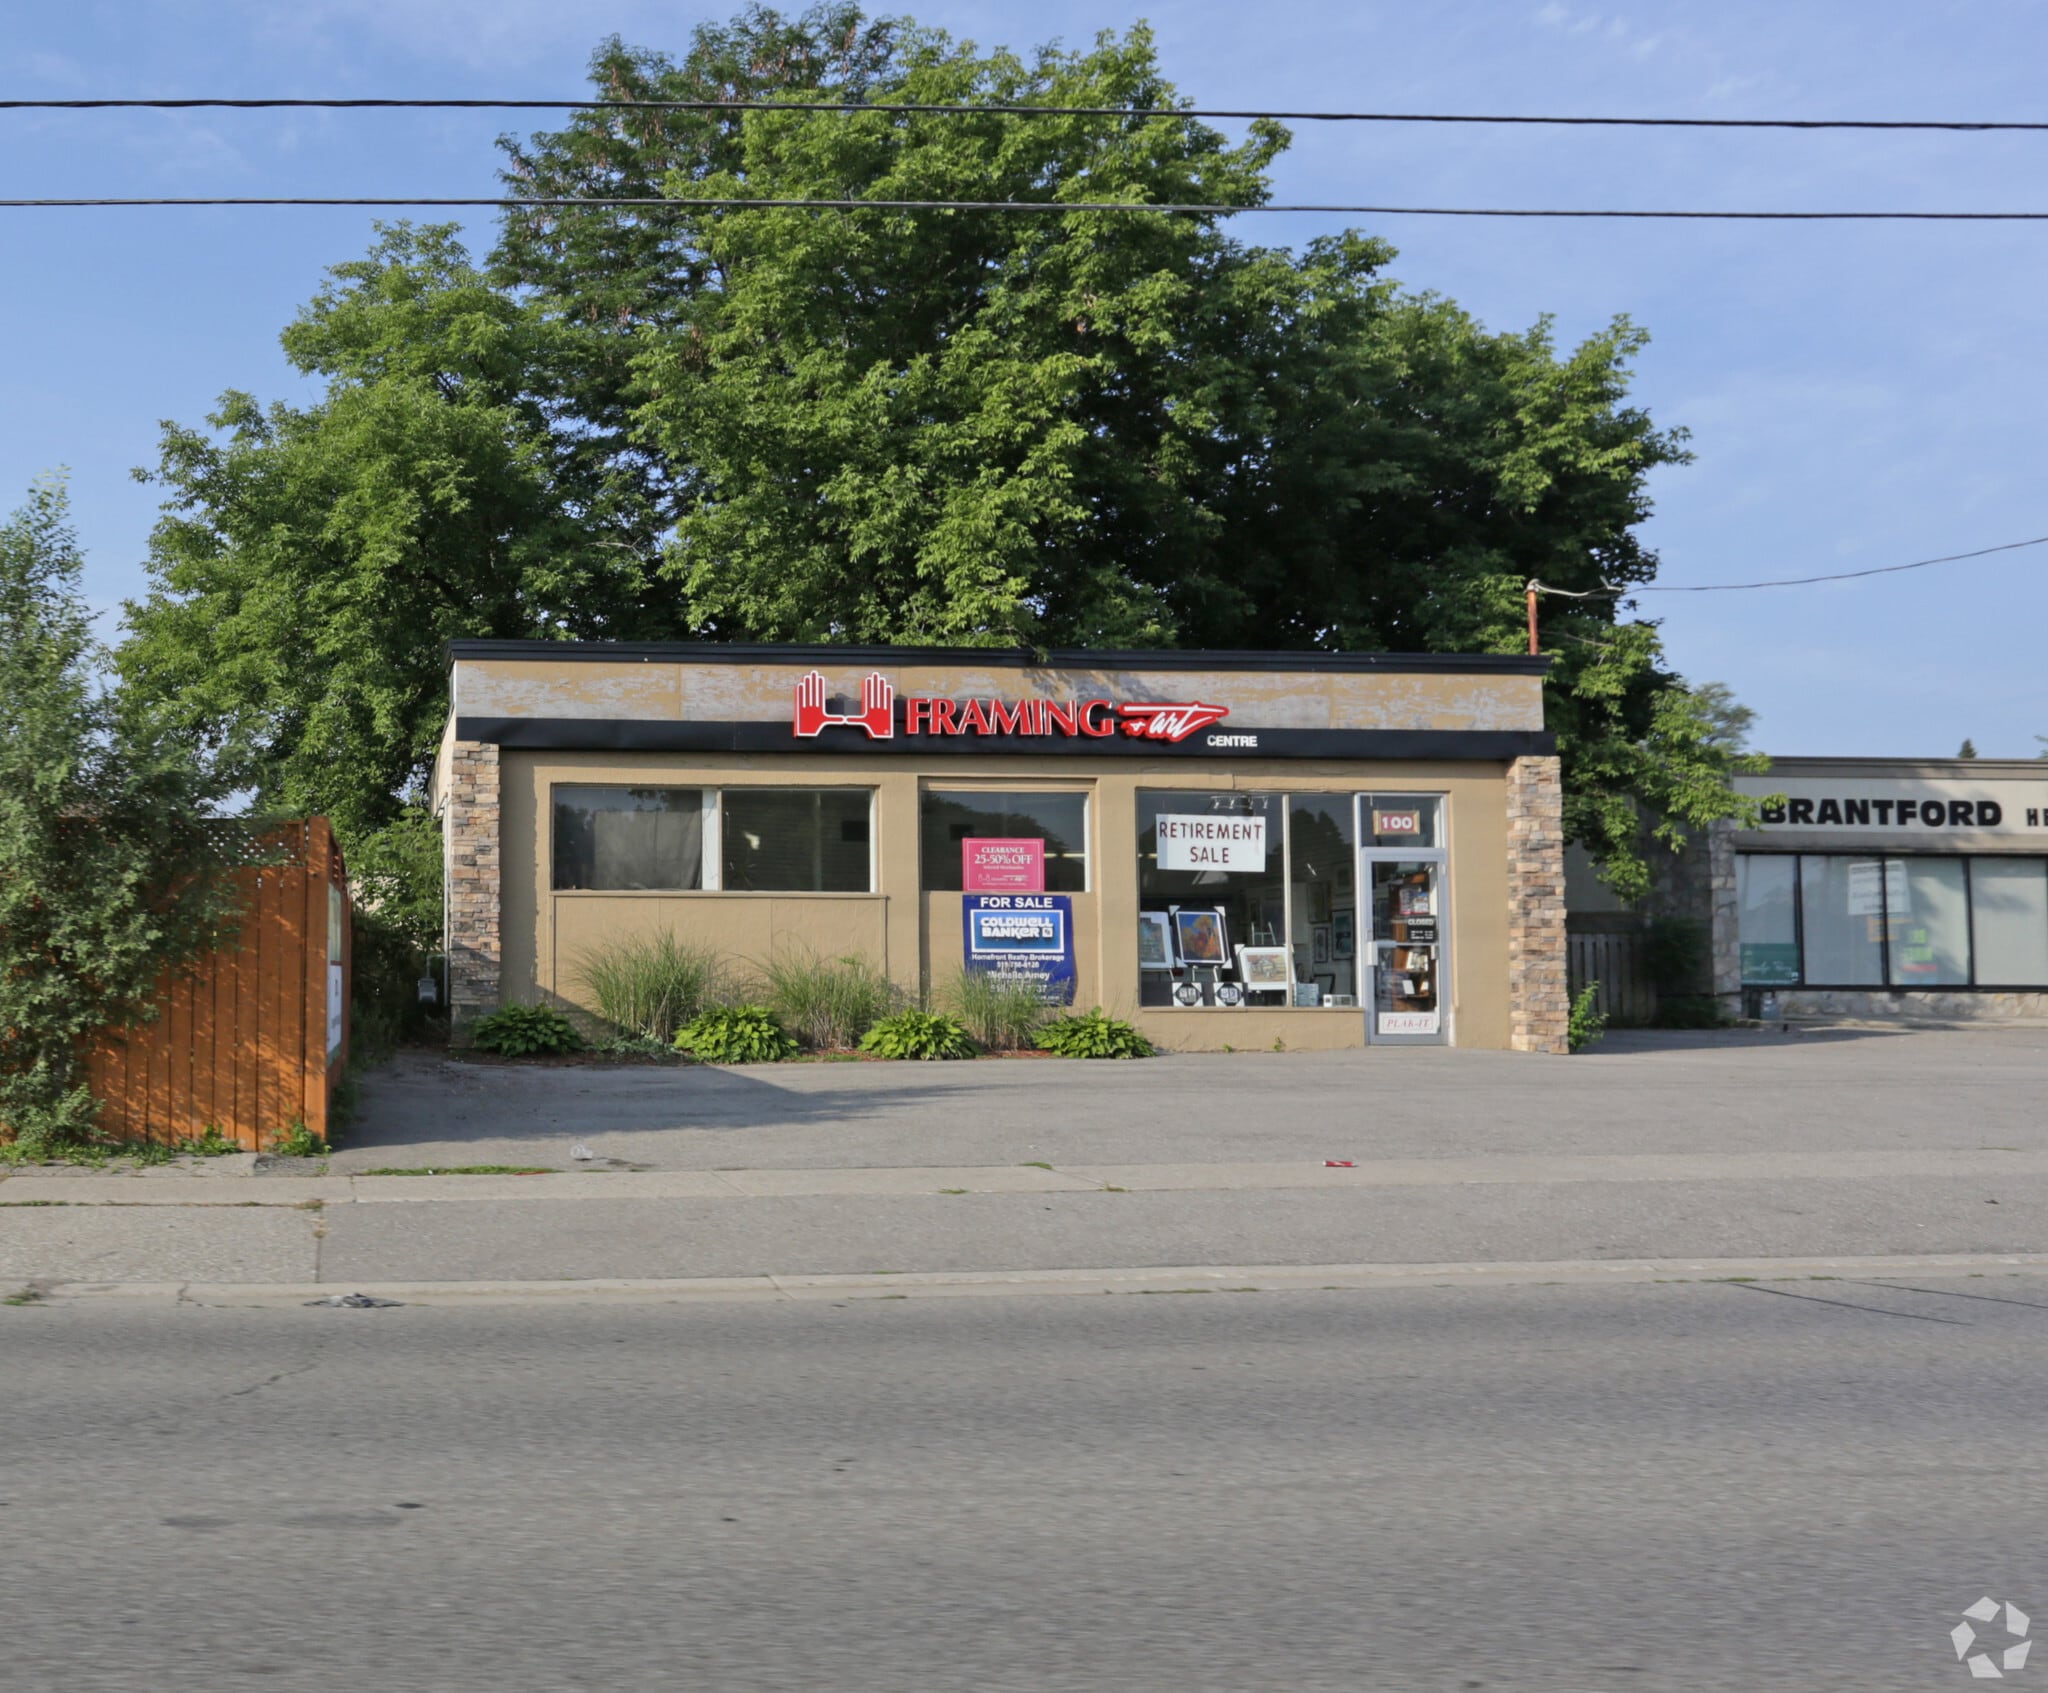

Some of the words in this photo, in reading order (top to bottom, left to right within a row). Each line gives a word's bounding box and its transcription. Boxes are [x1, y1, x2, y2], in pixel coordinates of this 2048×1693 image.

[906, 698, 1115, 737] FRAMING
[1206, 735, 1258, 747] CENTRE
[1760, 798, 2003, 827] BRANTFORD
[1381, 816, 1413, 830] 100
[1160, 822, 1263, 840] RETIREMENT
[981, 846, 1025, 854] CLEARANCE
[1190, 846, 1230, 863] SALE
[974, 854, 1011, 865] 25-50%
[1011, 854, 1034, 865] OFF
[980, 897, 1011, 908] FOR
[1014, 897, 1053, 908] SALE
